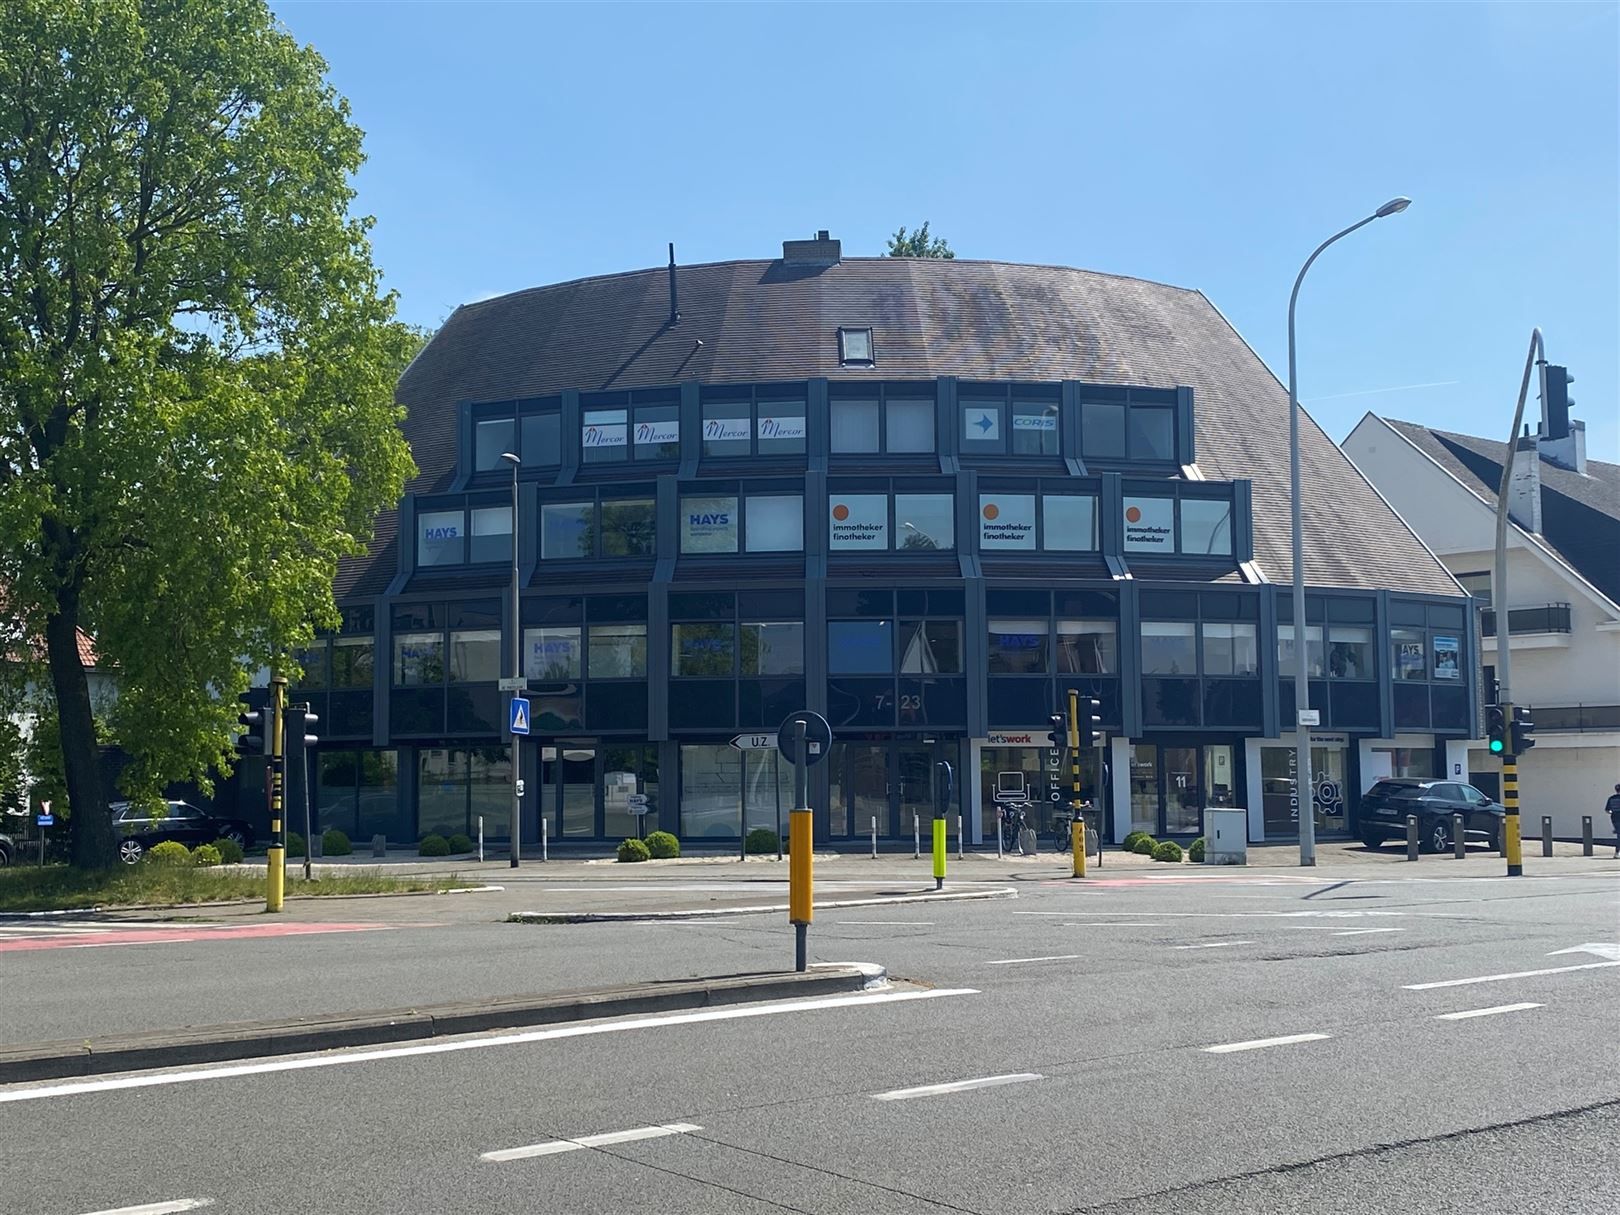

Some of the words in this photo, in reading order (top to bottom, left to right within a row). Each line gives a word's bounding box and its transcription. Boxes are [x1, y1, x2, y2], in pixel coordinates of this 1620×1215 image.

[637, 424, 677, 442] Mercor
[706, 421, 748, 439] Mercor
[761, 419, 804, 437] Mercor
[585, 427, 624, 445] Mercor
[690, 514, 729, 525] HAYS
[425, 527, 457, 539] HAYS
[984, 523, 1032, 531] immotheker
[833, 533, 876, 541] finotheker
[534, 641, 571, 653] HAYS
[751, 736, 771, 747] U.Z.
[1050, 748, 1060, 802] OFFICE
[1175, 775, 1186, 788] 11
[1289, 750, 1299, 823] INDUSTRY
